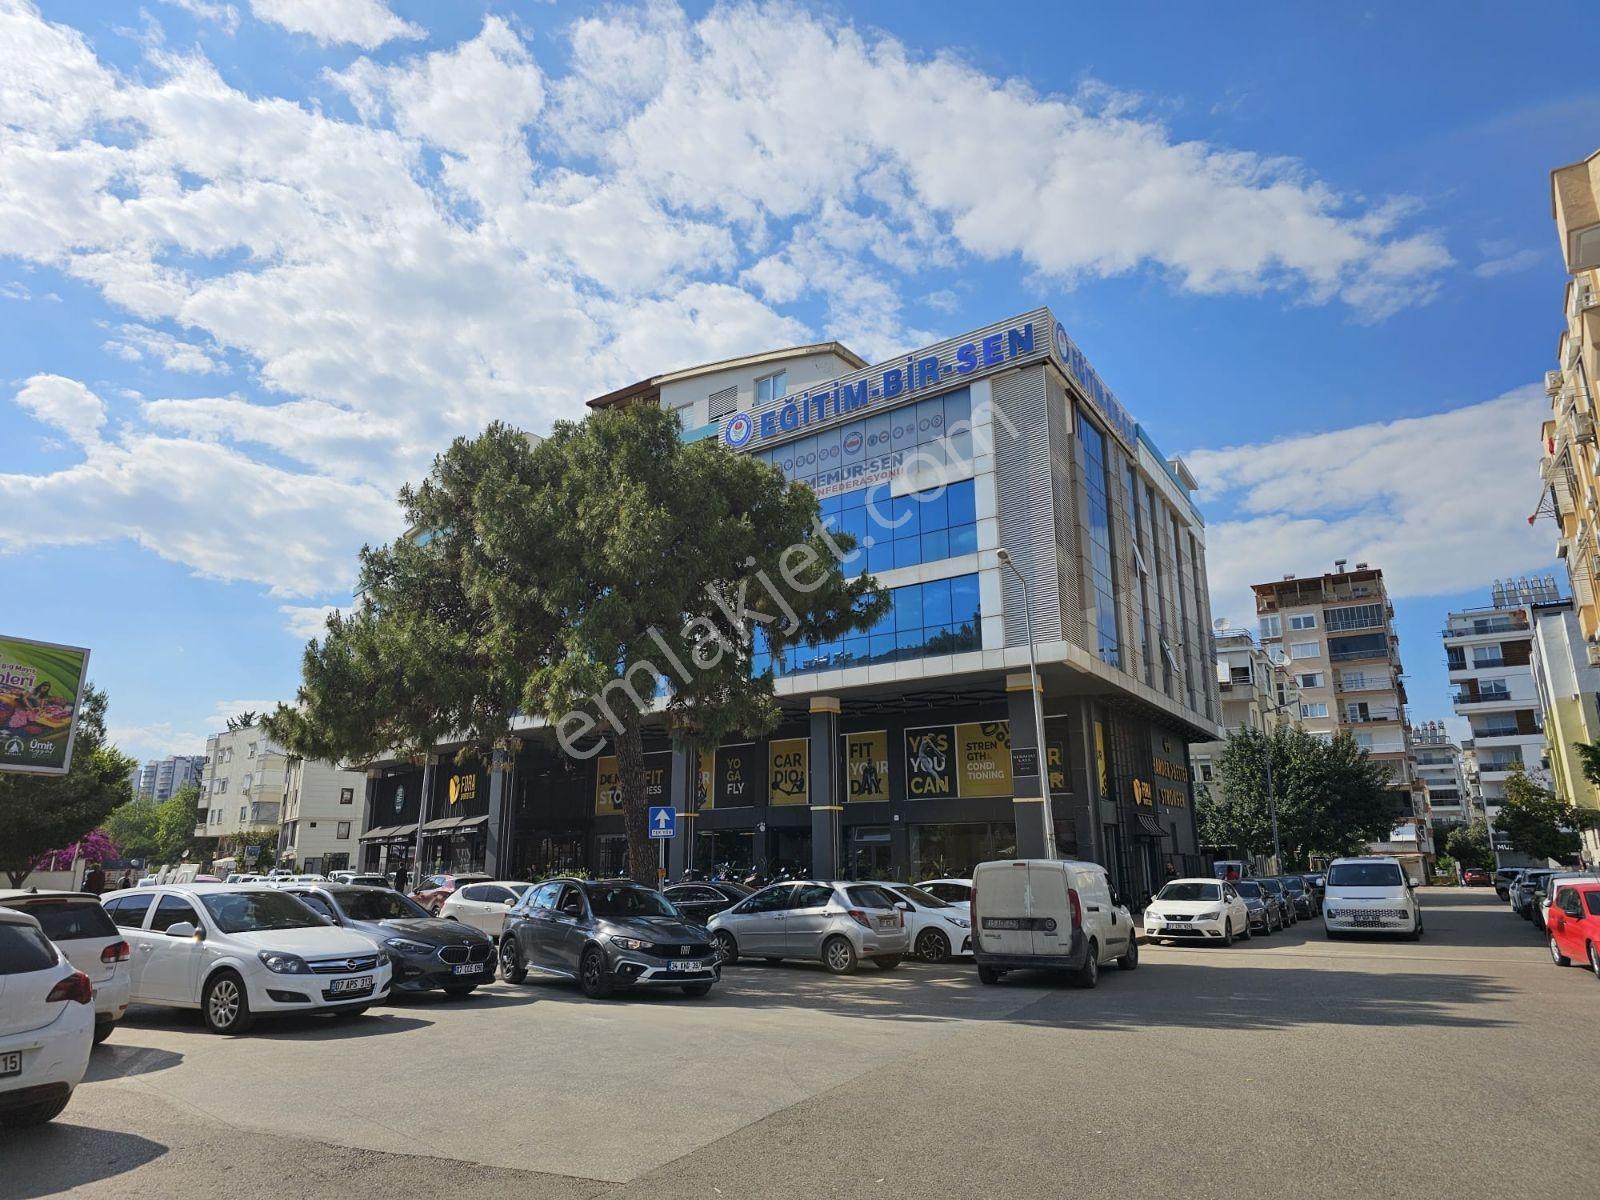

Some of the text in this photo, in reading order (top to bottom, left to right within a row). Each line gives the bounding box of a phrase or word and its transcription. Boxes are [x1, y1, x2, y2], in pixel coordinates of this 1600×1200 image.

[760, 323, 1035, 439] EĞİTİM-BİR-SEN
[30, 738, 52, 750] Ümit
[967, 741, 998, 751] STREN
[849, 742, 873, 758] FIT
[727, 758, 741, 767] YO
[774, 753, 802, 768] CAR
[967, 753, 986, 761] GTH
[967, 762, 996, 770] CONDI
[727, 769, 742, 781] GA
[967, 770, 1005, 780] TIONING
[727, 783, 745, 794] FLY
[911, 776, 949, 794] CAN
[346, 978, 358, 989] APS
[2, 1055, 17, 1071] 15
